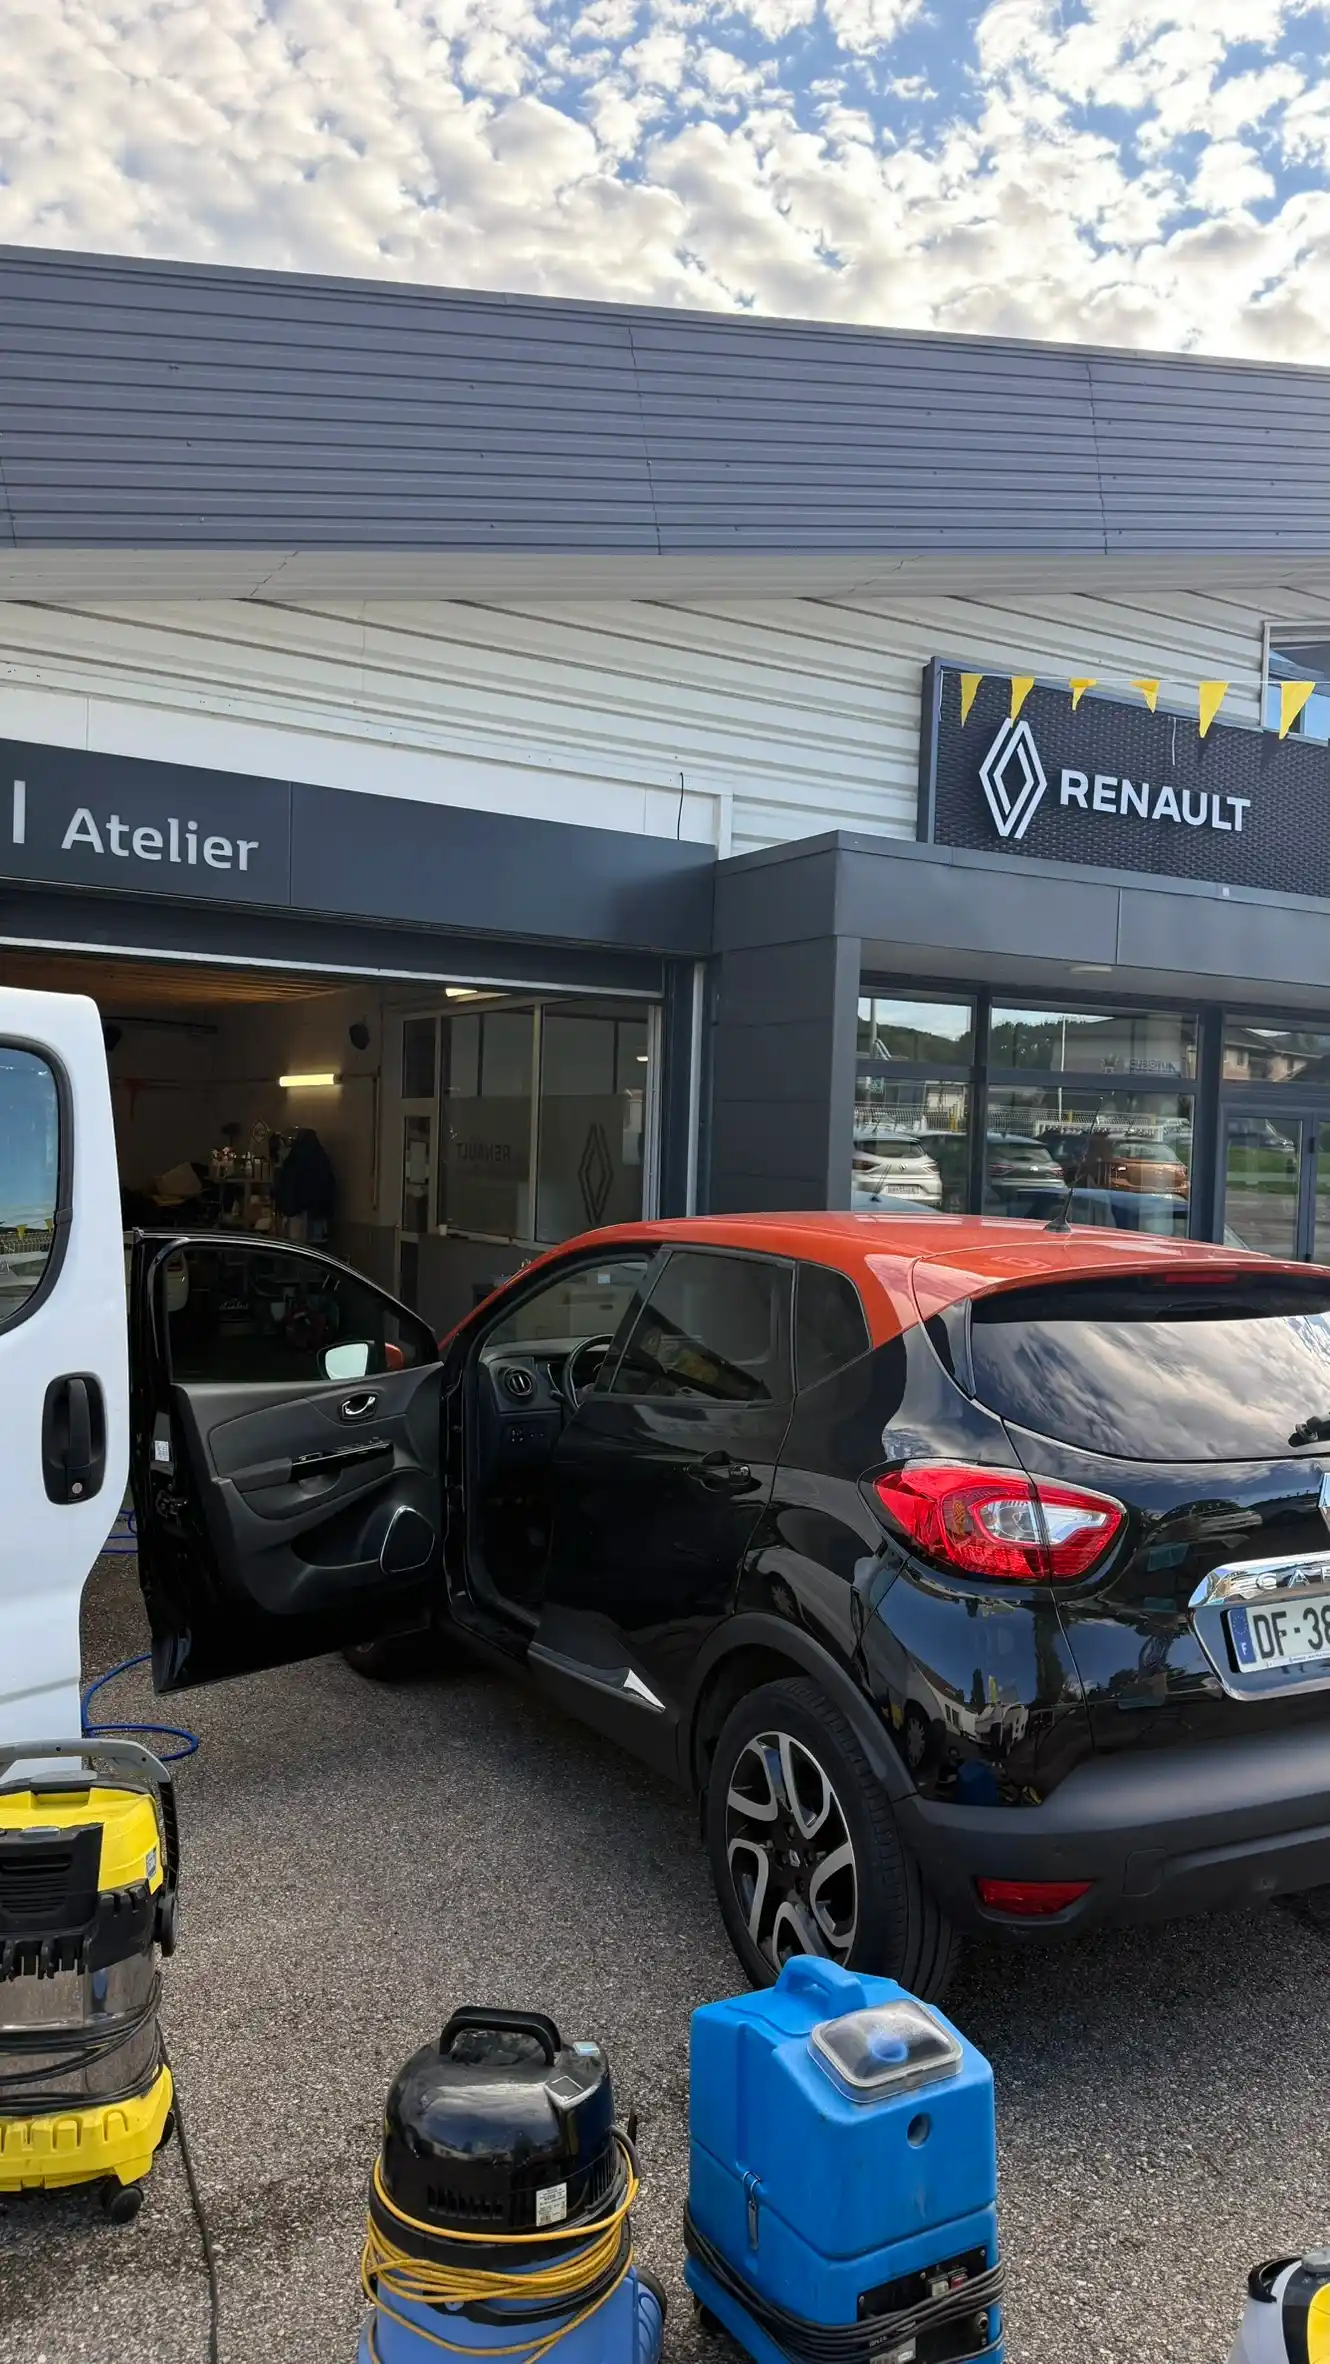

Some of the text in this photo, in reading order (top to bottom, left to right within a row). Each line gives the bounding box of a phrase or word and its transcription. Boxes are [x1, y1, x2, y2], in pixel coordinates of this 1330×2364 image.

[1060, 769, 1251, 832] RENAULT
[61, 807, 260, 871] Atelier
[1241, 1642, 1248, 1656] F
